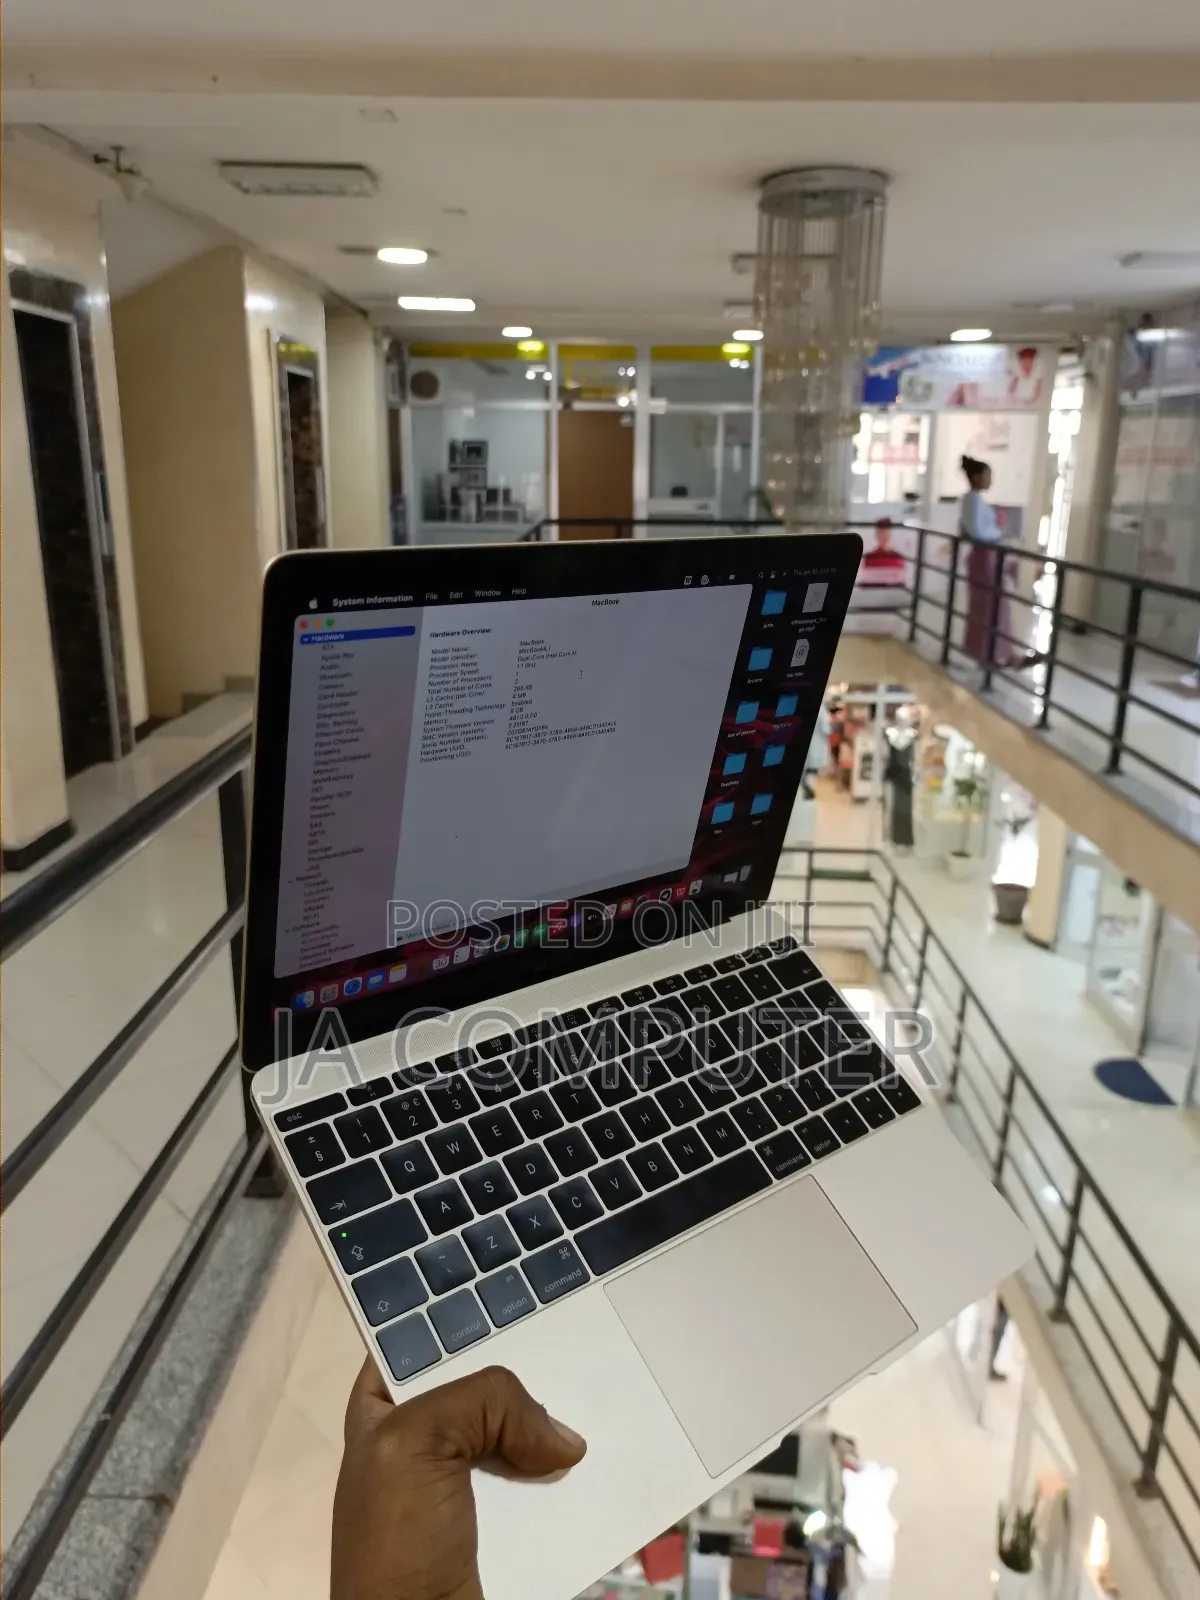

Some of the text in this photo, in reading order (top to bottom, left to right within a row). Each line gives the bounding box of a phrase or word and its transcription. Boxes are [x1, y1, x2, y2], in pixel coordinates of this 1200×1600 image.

[333, 587, 528, 608] System Information File Edit Window Help
[591, 597, 620, 608] MacBook
[311, 633, 345, 643] Hardware
[429, 630, 461, 640] Hardware
[519, 638, 545, 648] MacBook
[429, 663, 459, 673] Processor
[429, 671, 459, 680] Processor
[428, 679, 451, 688] Number
[443, 684, 466, 694] Number
[435, 693, 455, 703] Cache
[511, 698, 534, 708] Enabled
[515, 706, 525, 714] GB
[421, 733, 436, 742] SMC
[437, 730, 459, 739] Version
[423, 726, 445, 735] System
[439, 737, 462, 747] Number
[420, 747, 448, 757] Hardware
[532, 1068, 544, 1081] 5
[493, 1083, 505, 1096] 4
[450, 1099, 464, 1111] 3
[570, 1093, 582, 1106] T
[400, 1101, 411, 1112] @
[286, 1113, 303, 1123] esc
[407, 1115, 420, 1128] 2
[532, 1109, 545, 1122] R
[640, 1112, 652, 1125] H
[491, 1125, 503, 1138] E
[604, 1128, 616, 1141] G
[715, 1126, 729, 1141] M
[362, 1133, 372, 1145] 1
[445, 1141, 463, 1155] W
[565, 1145, 577, 1158] F
[682, 1143, 695, 1157] N
[403, 1160, 418, 1174] Q
[647, 1159, 659, 1173] B
[775, 1152, 806, 1172] command
[526, 1162, 538, 1176] D
[483, 1181, 495, 1194] S
[609, 1178, 622, 1191] V
[439, 1200, 452, 1213] A
[570, 1195, 582, 1209] C
[528, 1216, 542, 1229] X
[486, 1235, 499, 1250] Z
[543, 1267, 583, 1294] command
[501, 1295, 528, 1317] option
[450, 1319, 481, 1343] control
[401, 1355, 413, 1368] fn
